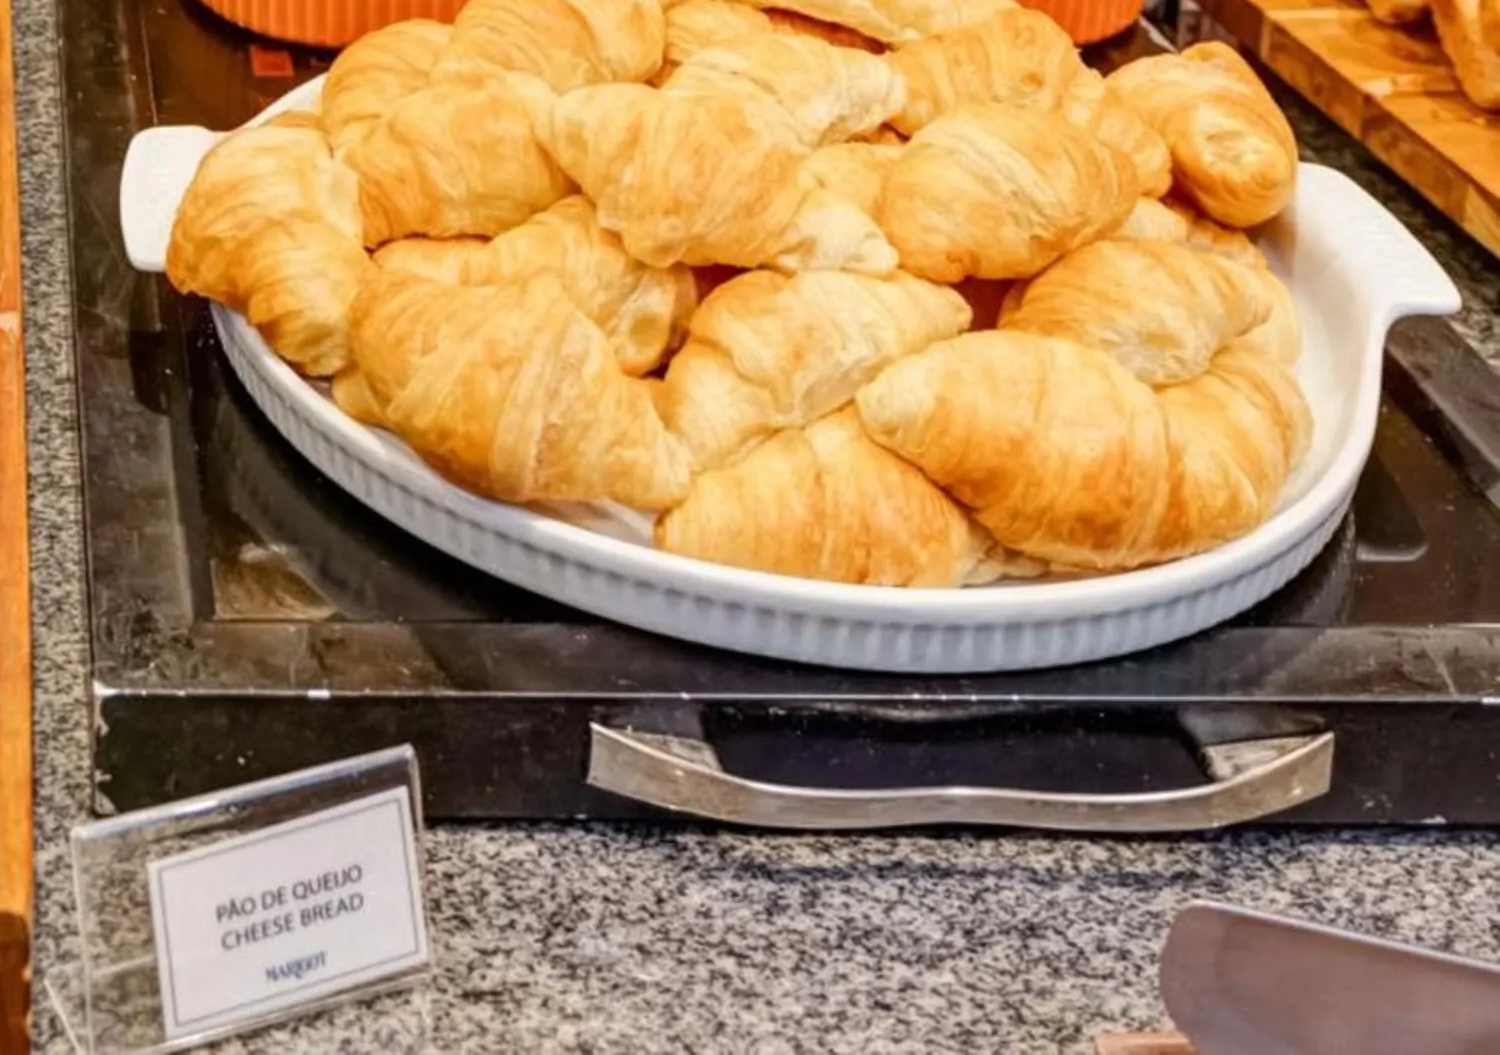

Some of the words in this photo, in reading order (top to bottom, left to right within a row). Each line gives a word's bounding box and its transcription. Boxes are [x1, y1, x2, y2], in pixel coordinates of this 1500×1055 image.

[215, 896, 257, 923] PÃO
[261, 886, 288, 911] DE
[291, 864, 363, 900] QUEIJO
[220, 912, 294, 951] CHEESE
[299, 893, 365, 927] BREAD
